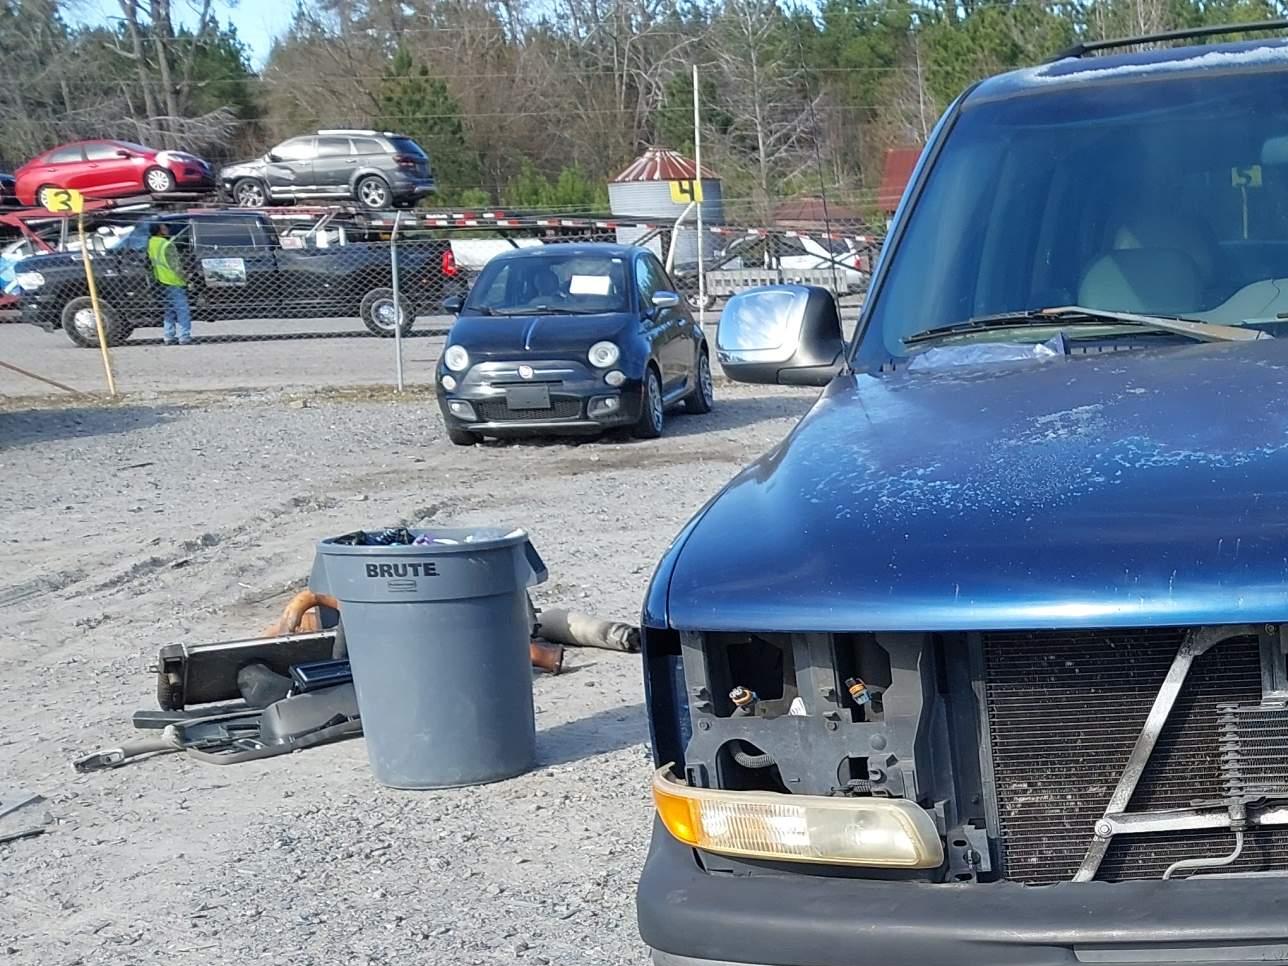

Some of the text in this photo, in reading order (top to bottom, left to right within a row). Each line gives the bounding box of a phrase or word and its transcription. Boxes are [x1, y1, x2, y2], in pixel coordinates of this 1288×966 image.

[54, 190, 73, 212] 3
[679, 180, 695, 201] 4
[366, 562, 437, 578] BRUTE
